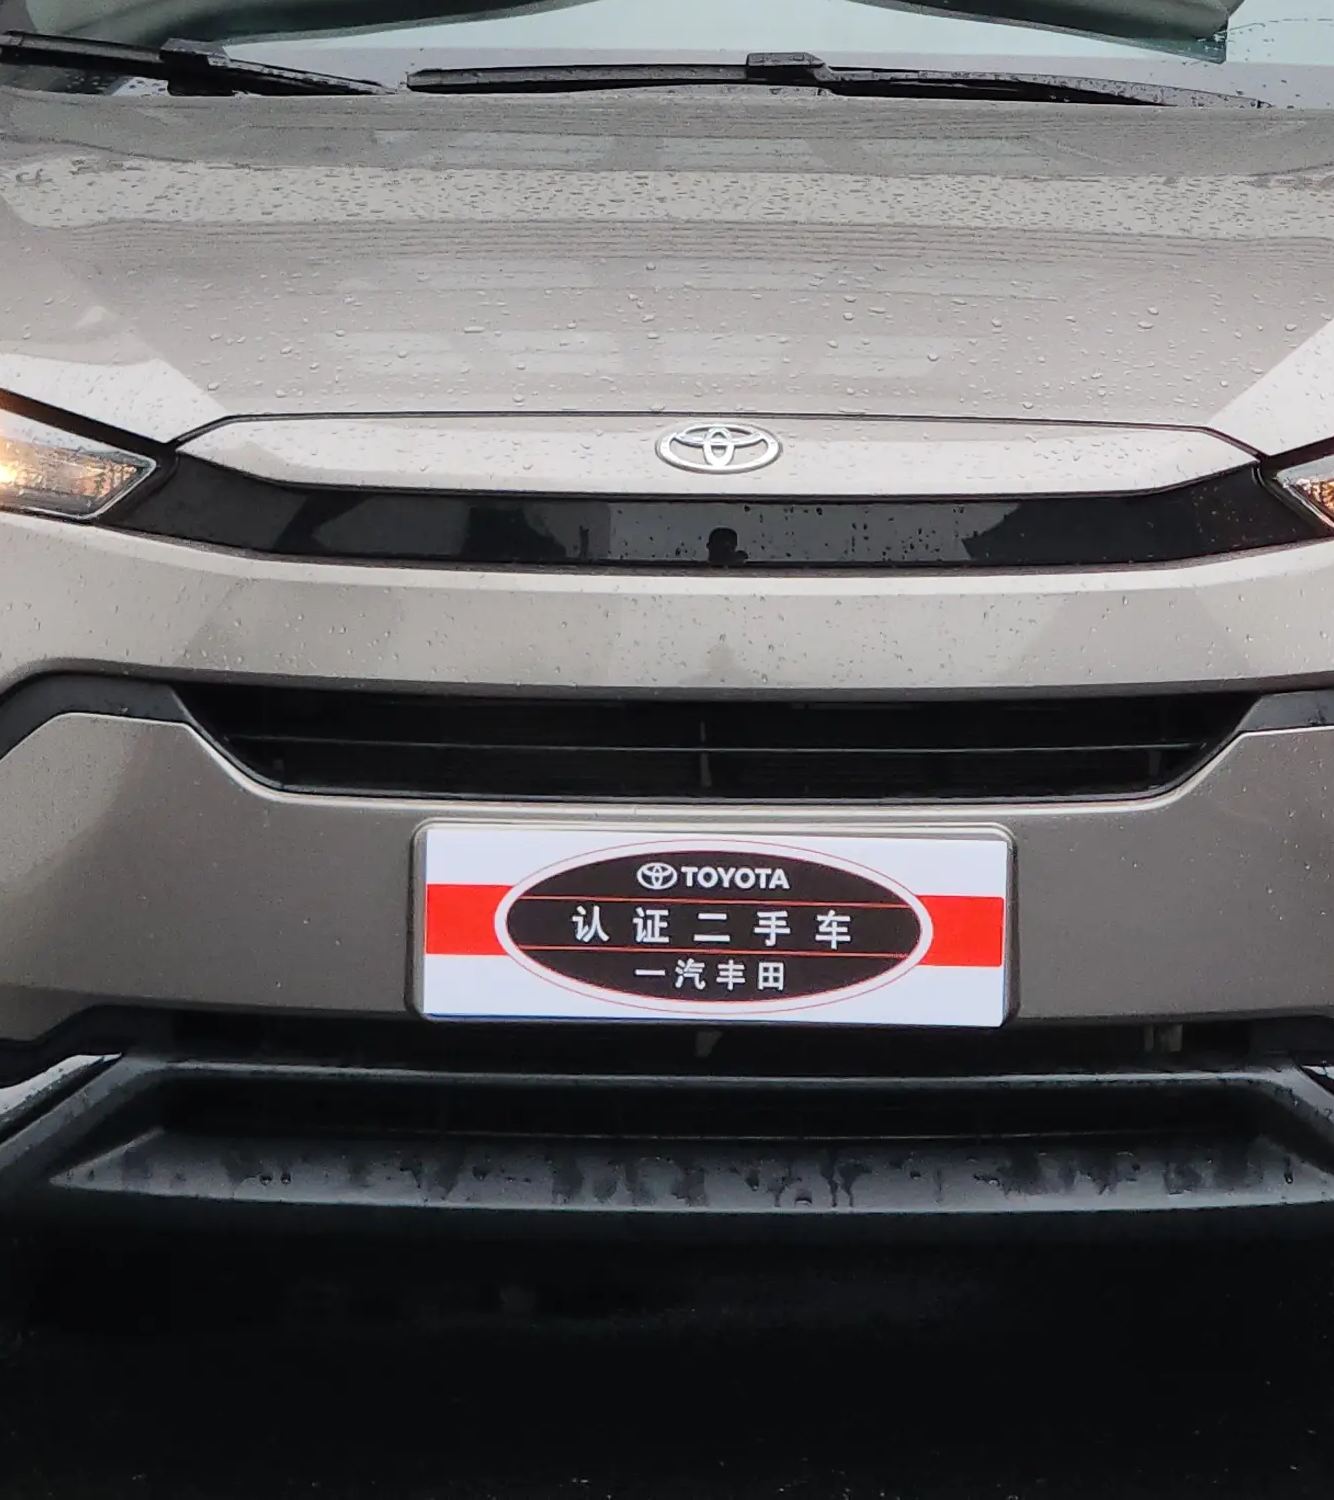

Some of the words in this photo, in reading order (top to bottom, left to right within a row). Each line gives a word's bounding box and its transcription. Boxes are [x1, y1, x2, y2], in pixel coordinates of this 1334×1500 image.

[680, 865, 790, 890] TOYOTA
[571, 906, 852, 950] 认证二手车
[634, 958, 786, 992] 一汽丰田
